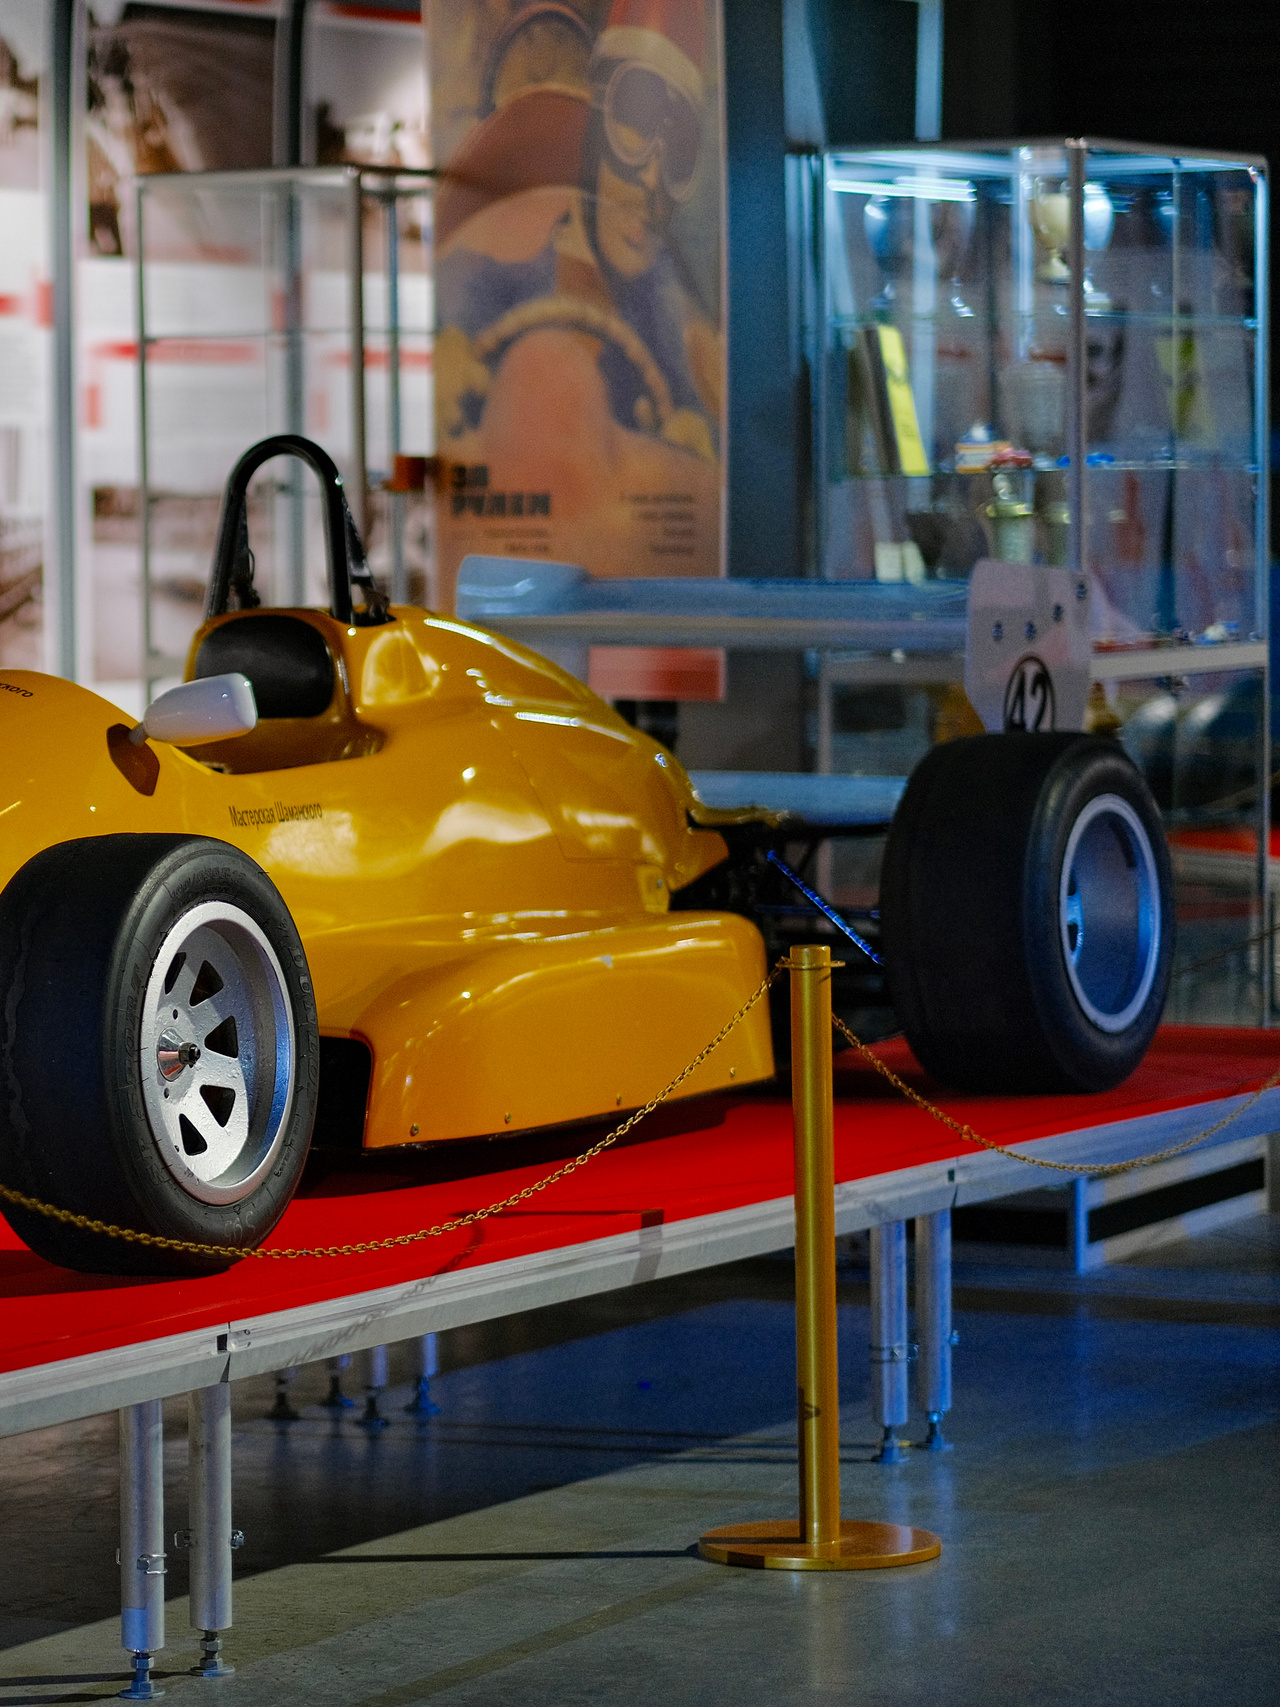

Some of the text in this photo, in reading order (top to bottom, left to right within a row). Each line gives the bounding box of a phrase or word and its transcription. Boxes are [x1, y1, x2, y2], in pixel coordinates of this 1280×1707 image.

[1009, 669, 1047, 732] 42
[228, 801, 323, 831] Мастерская Шаманского
